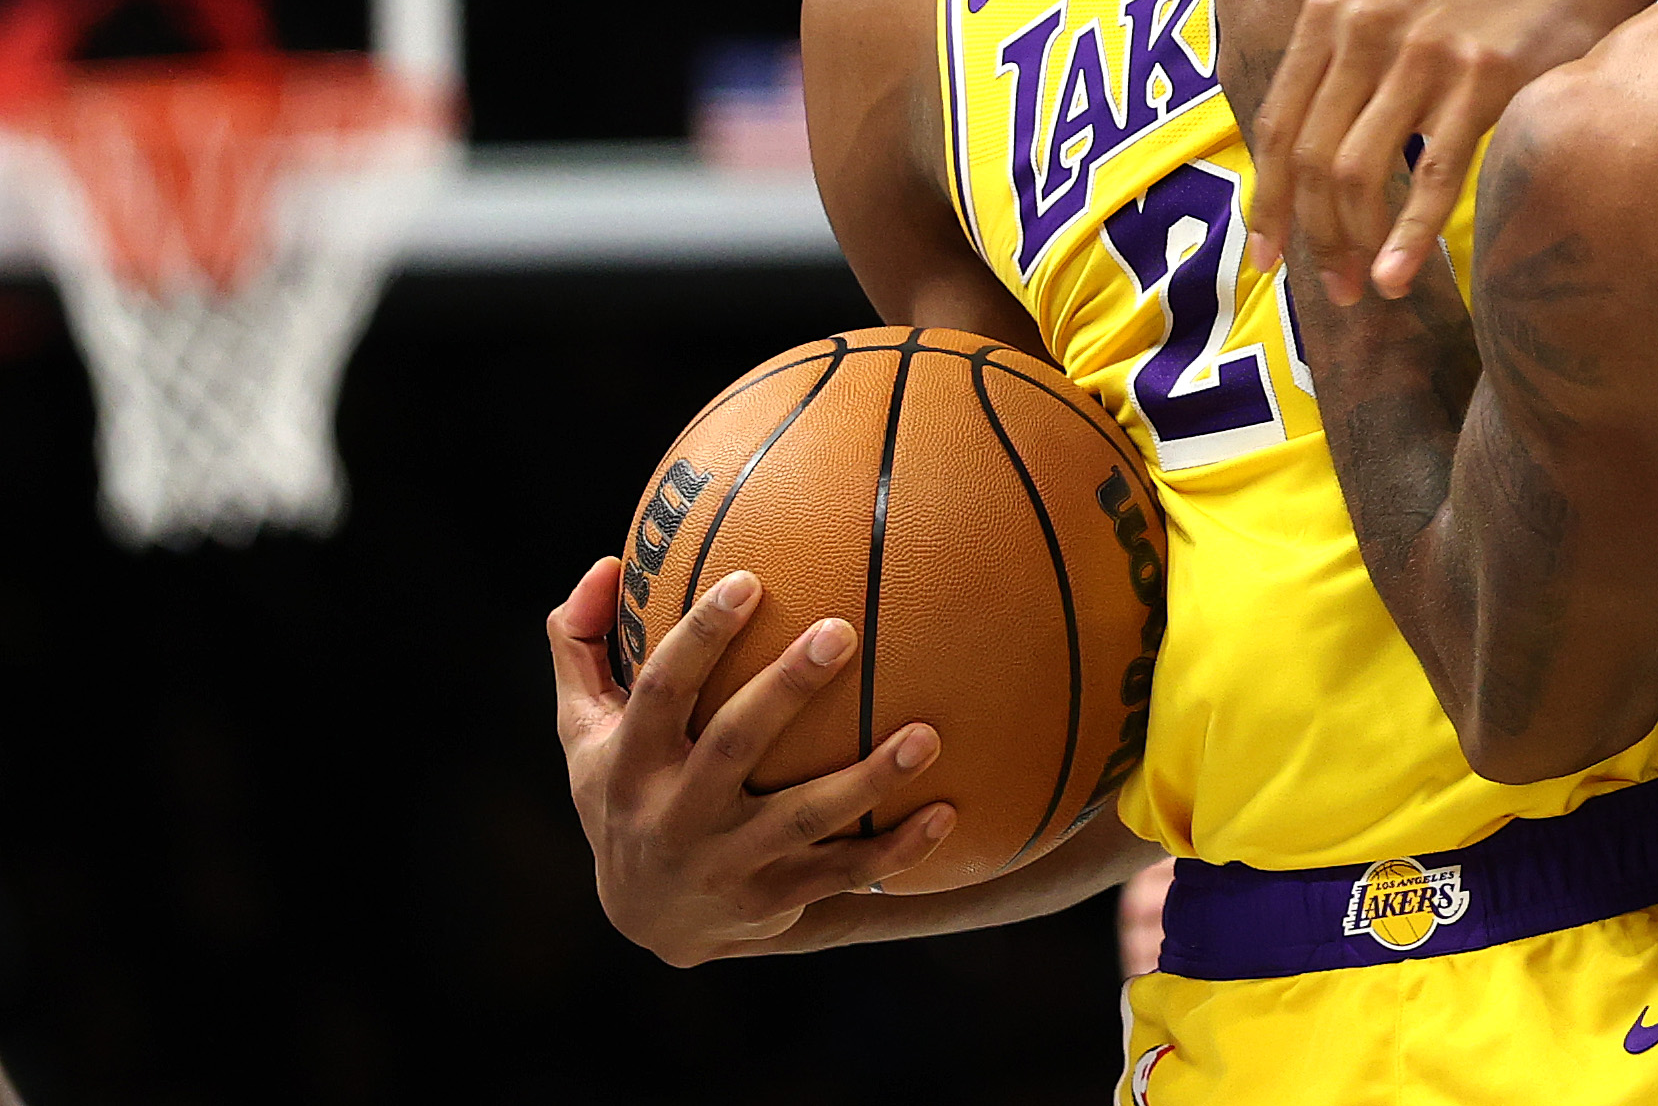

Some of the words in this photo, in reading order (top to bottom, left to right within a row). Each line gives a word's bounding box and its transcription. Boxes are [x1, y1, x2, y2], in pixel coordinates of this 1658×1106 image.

[1101, 159, 1318, 471] 2
[1375, 879, 1396, 891] LOS
[1396, 870, 1455, 888] ANGELES
[1349, 882, 1465, 931] LAKERS
